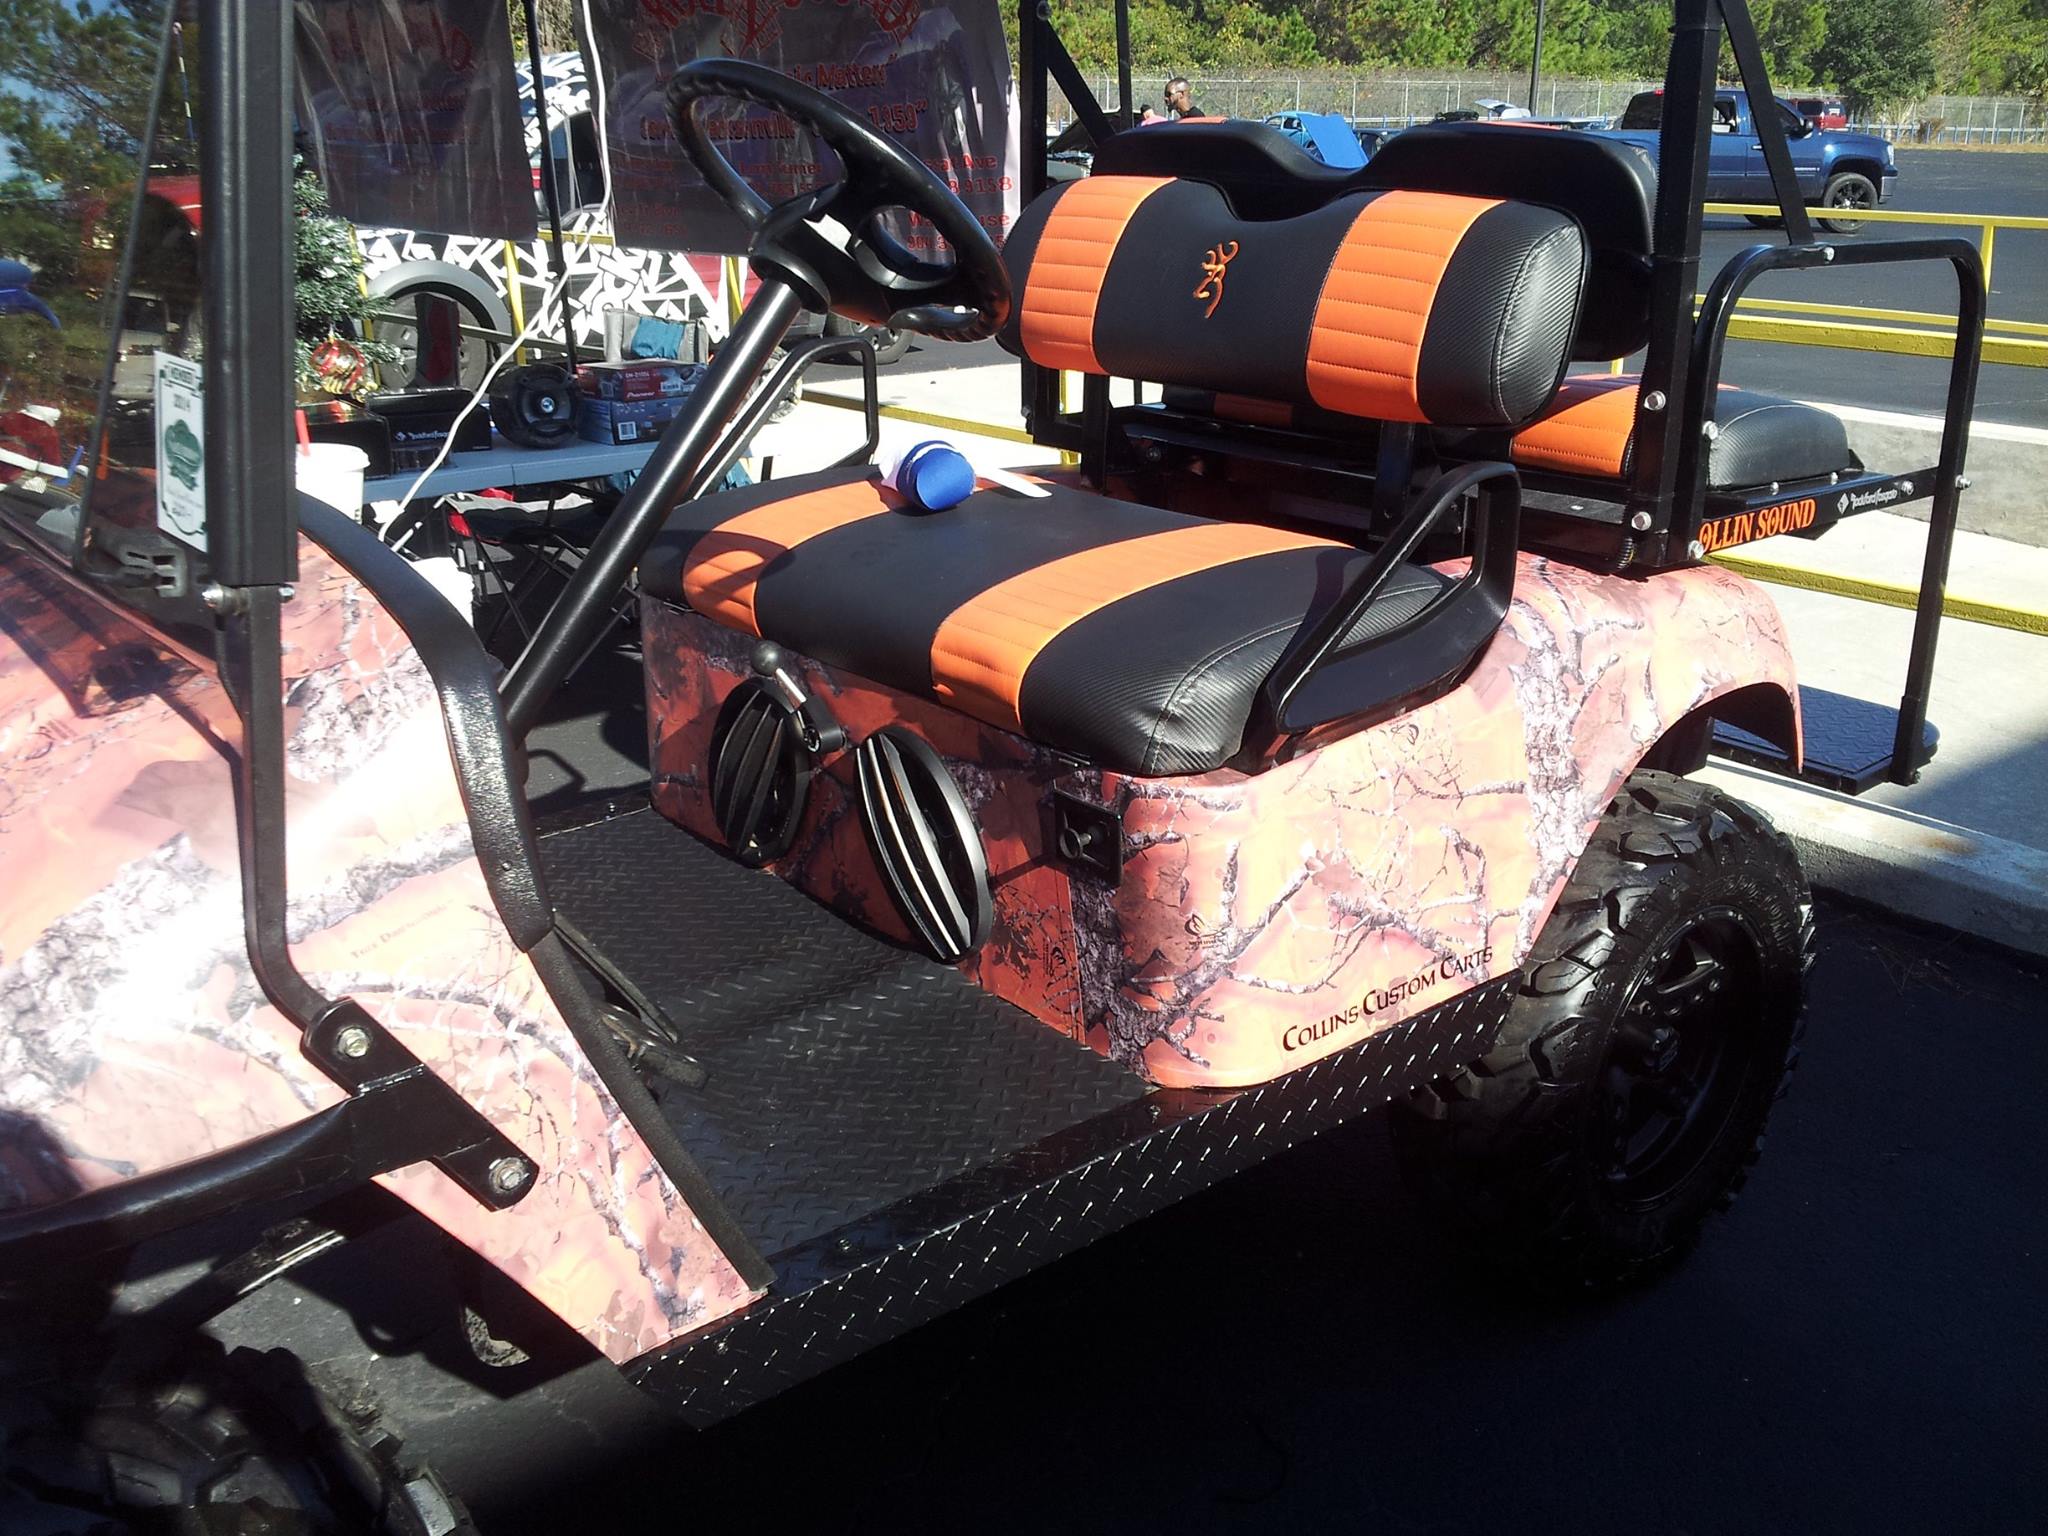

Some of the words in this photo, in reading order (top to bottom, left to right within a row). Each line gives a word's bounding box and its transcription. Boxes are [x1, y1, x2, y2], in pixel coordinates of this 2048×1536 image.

[1699, 511, 1755, 553] OLLIN
[1755, 498, 1817, 540] SOUND
[1282, 1005, 1359, 1051] COLLINS
[1362, 970, 1436, 1016] CUSTOM
[1440, 946, 1493, 979] CARTS
